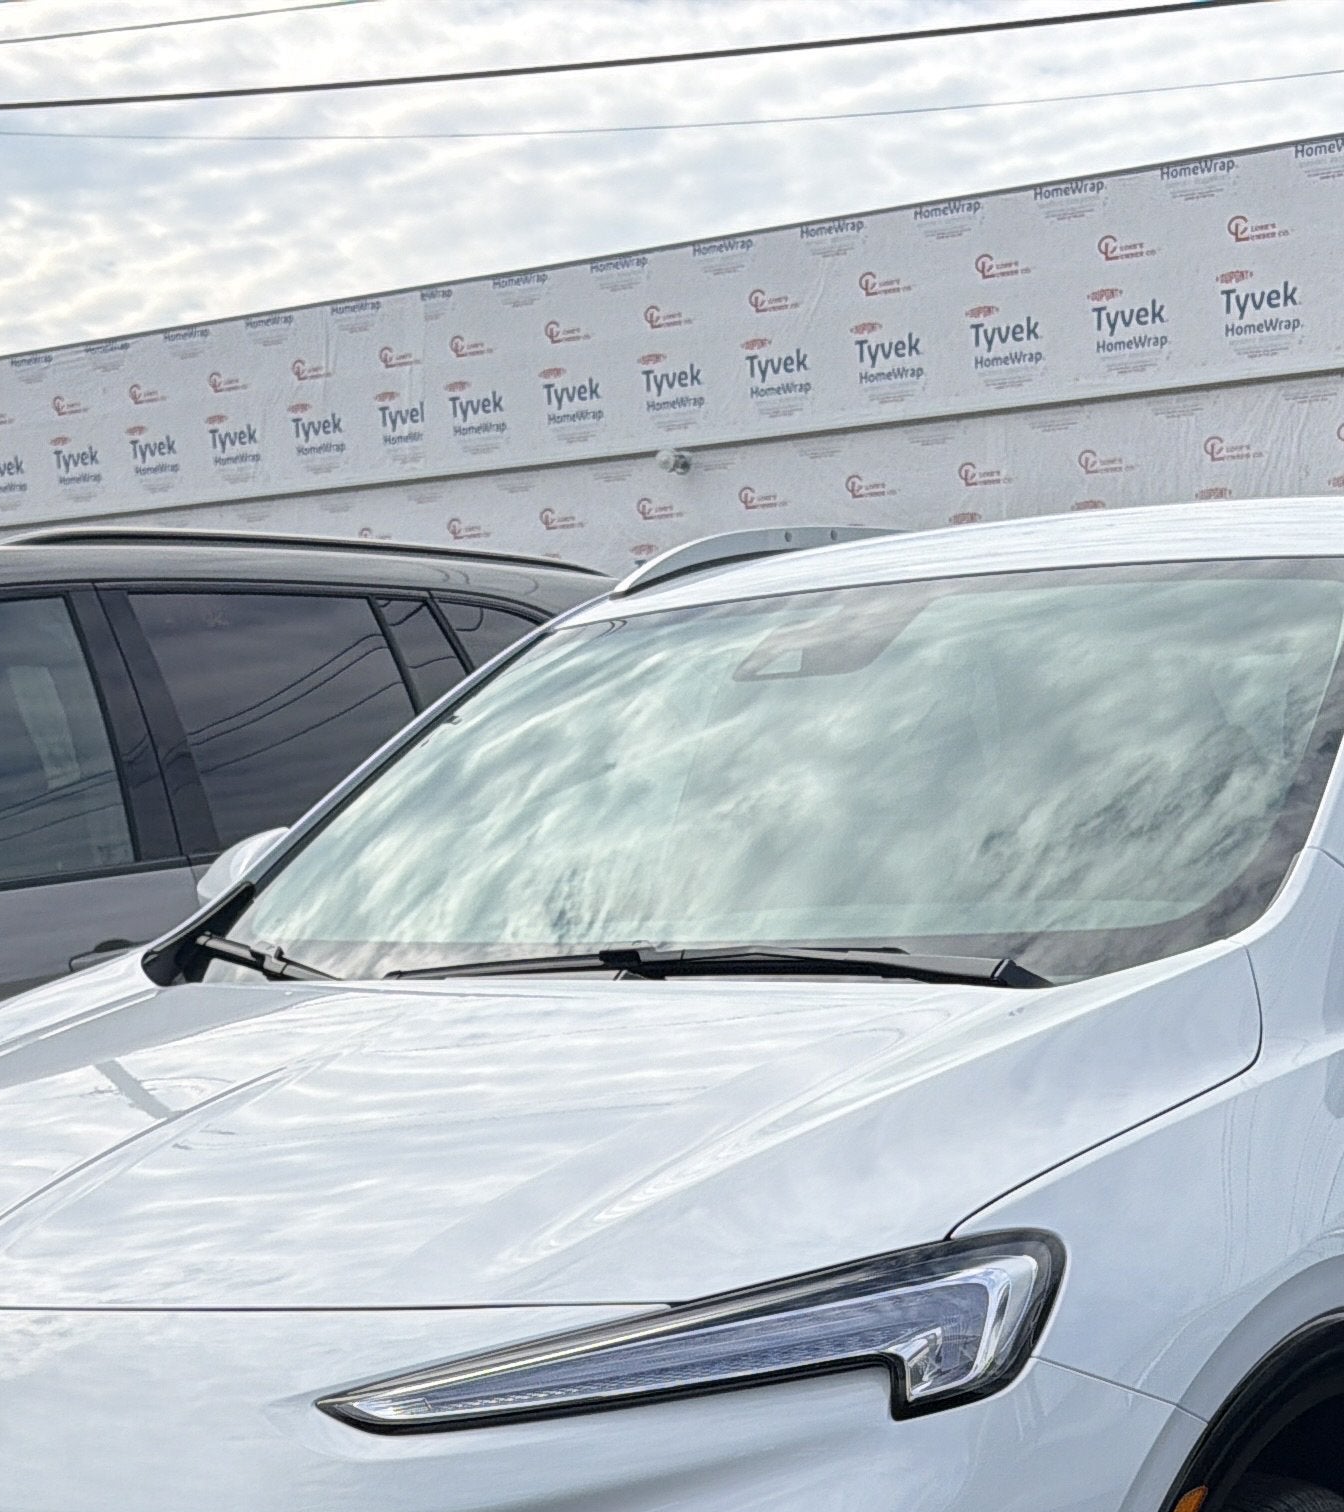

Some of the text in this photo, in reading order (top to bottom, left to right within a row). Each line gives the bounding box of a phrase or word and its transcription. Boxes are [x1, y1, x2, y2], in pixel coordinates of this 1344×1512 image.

[1160, 158, 1236, 182] HomeWrap
[1033, 180, 1105, 202] HomeWrap
[913, 200, 982, 222] HomeWrap
[1220, 281, 1297, 321] Tyvek
[1091, 299, 1165, 338] Tyvek
[1224, 318, 1301, 339] HomeWrap
[970, 316, 1040, 354] Tyvek
[1096, 335, 1168, 356] HomeWrap
[745, 348, 808, 383] Tyvek
[854, 333, 921, 369] Tyvek
[974, 351, 1043, 371] HomeWrap
[641, 363, 702, 397] Tyvek
[749, 381, 812, 400] HomeWrap
[859, 366, 925, 386] HomeWrap
[448, 390, 504, 422] Tyvek
[542, 377, 601, 410] Tyvek
[646, 395, 706, 413] HomeWrap
[291, 412, 343, 443] Tyvek
[547, 408, 604, 426] HomeWrap
[129, 435, 177, 465] Tyvek
[208, 424, 258, 454] Tyvek
[53, 446, 99, 475] Tyvek
